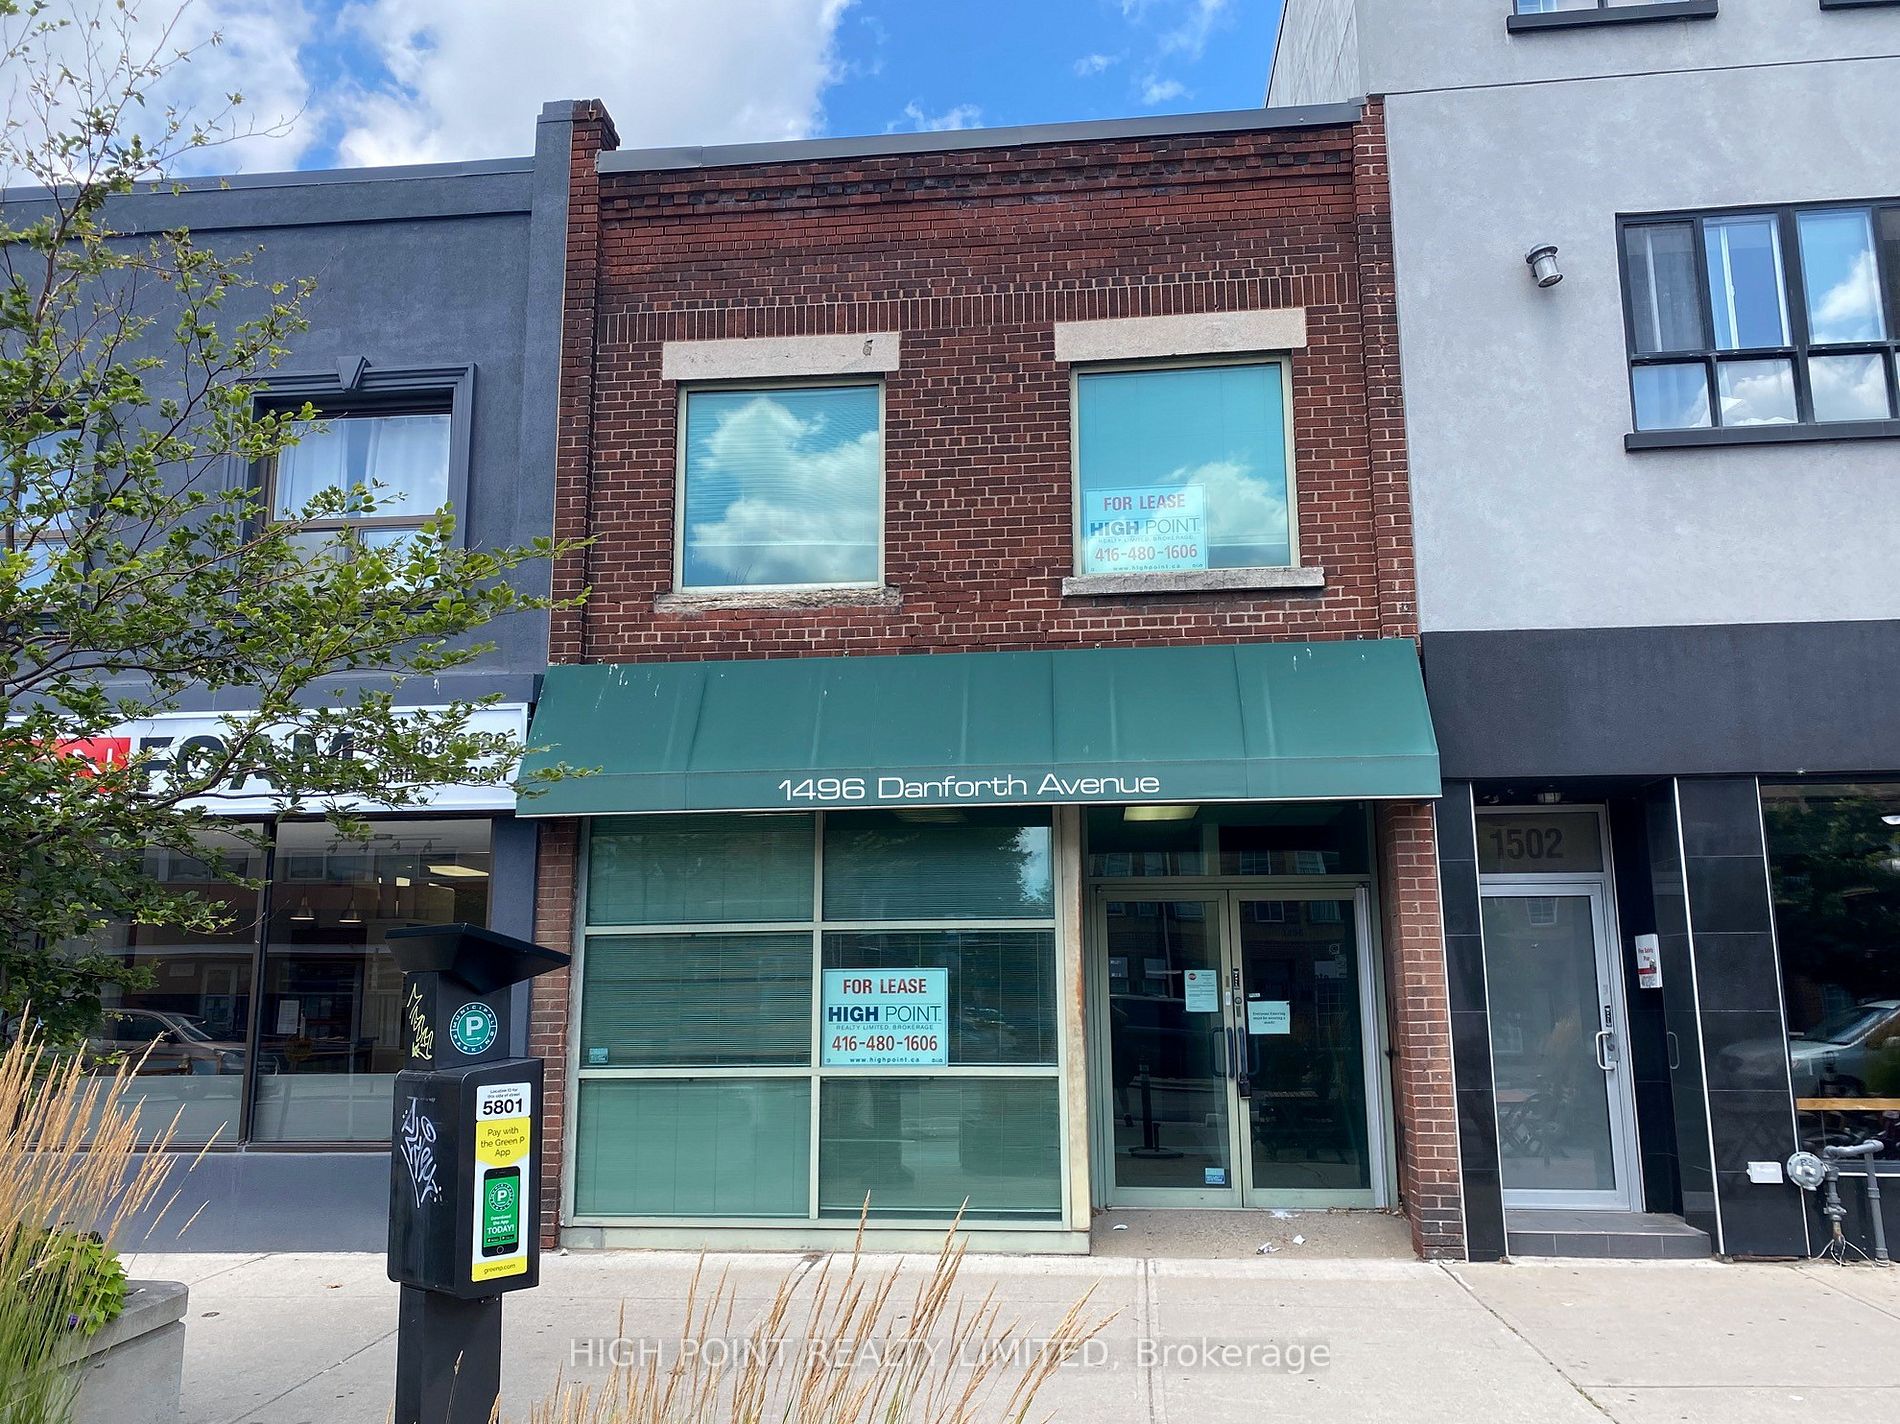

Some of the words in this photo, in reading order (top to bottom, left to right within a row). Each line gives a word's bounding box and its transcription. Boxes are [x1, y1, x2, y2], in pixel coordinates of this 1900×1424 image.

[1103, 496, 1133, 512] FOR
[1139, 493, 1185, 510] LEASE
[1089, 520, 1139, 537] HIGH
[1145, 517, 1201, 534] POINT
[1095, 543, 1198, 562] 416-480-1606
[1112, 564, 1181, 572] www.highpoint.ca
[778, 777, 866, 801] 1496
[877, 774, 1027, 799] Danforth
[1036, 773, 1160, 796] Avenue
[1489, 827, 1564, 860] 1502
[843, 978, 872, 994] FOR
[880, 978, 927, 994] LEASE
[452, 1004, 495, 1029] MUNICIPAL
[828, 1005, 879, 1022] HIGH
[885, 1005, 942, 1022] POINT
[466, 1016, 484, 1036] P
[452, 1031, 495, 1052] PARKING
[831, 1035, 938, 1052] 416-480-1606
[482, 1097, 523, 1116] 5801
[487, 1128, 501, 1138] Pay
[503, 1126, 519, 1136] with
[480, 1140, 494, 1148] the
[494, 1138, 518, 1147] Green
[519, 1135, 526, 1144] P
[494, 1148, 511, 1158] App
[487, 1224, 515, 1234] TODAY!
[483, 1263, 516, 1275] greenp.com
